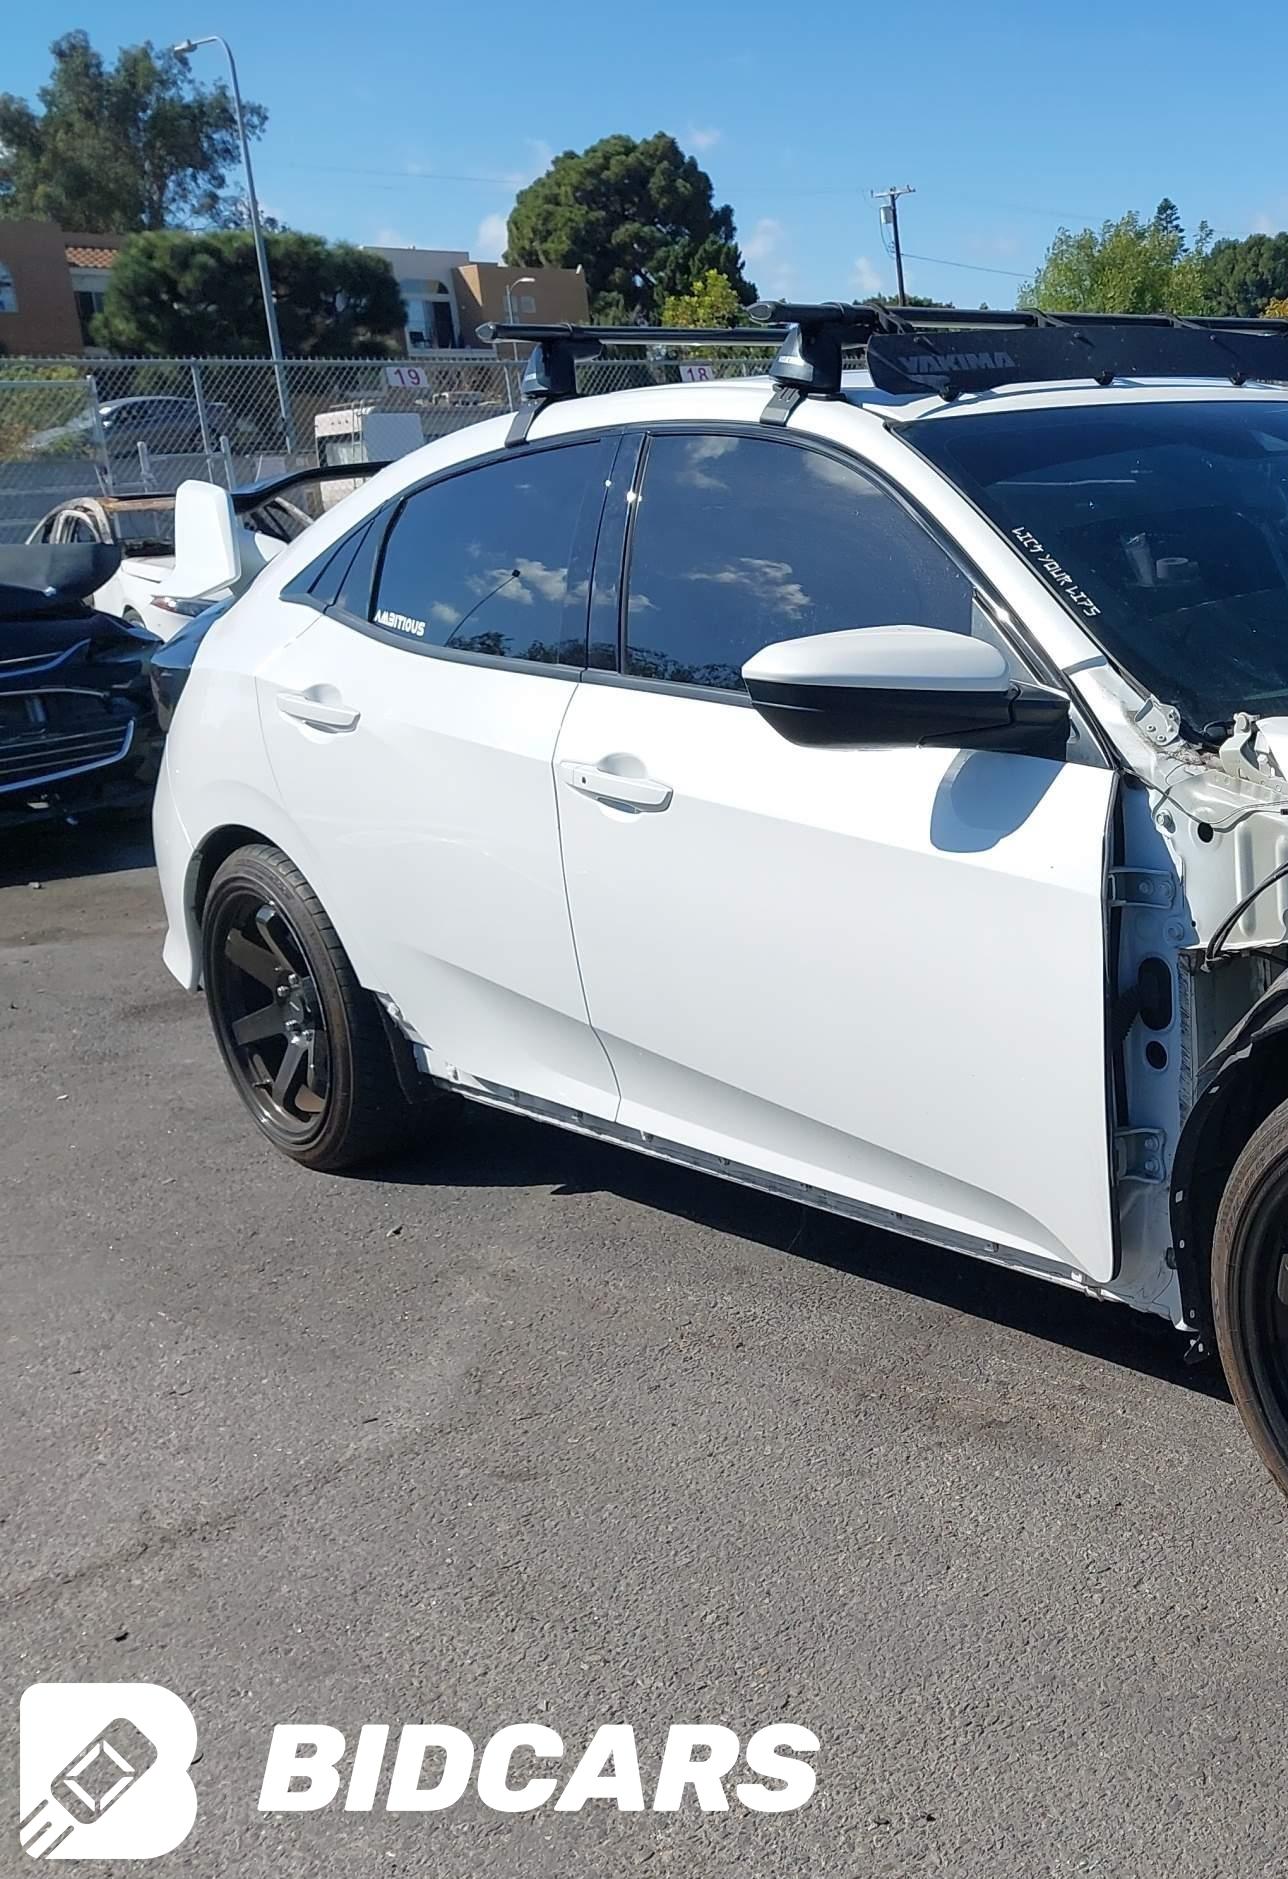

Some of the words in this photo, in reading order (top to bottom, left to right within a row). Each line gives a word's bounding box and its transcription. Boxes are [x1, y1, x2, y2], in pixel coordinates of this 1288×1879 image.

[687, 367, 709, 381] 18
[897, 351, 1016, 374] YAKIMA
[394, 368, 420, 385] 19
[1038, 553, 1073, 586] YOUR
[1065, 585, 1101, 616] LIPS
[373, 609, 426, 637] AMBITIOUS
